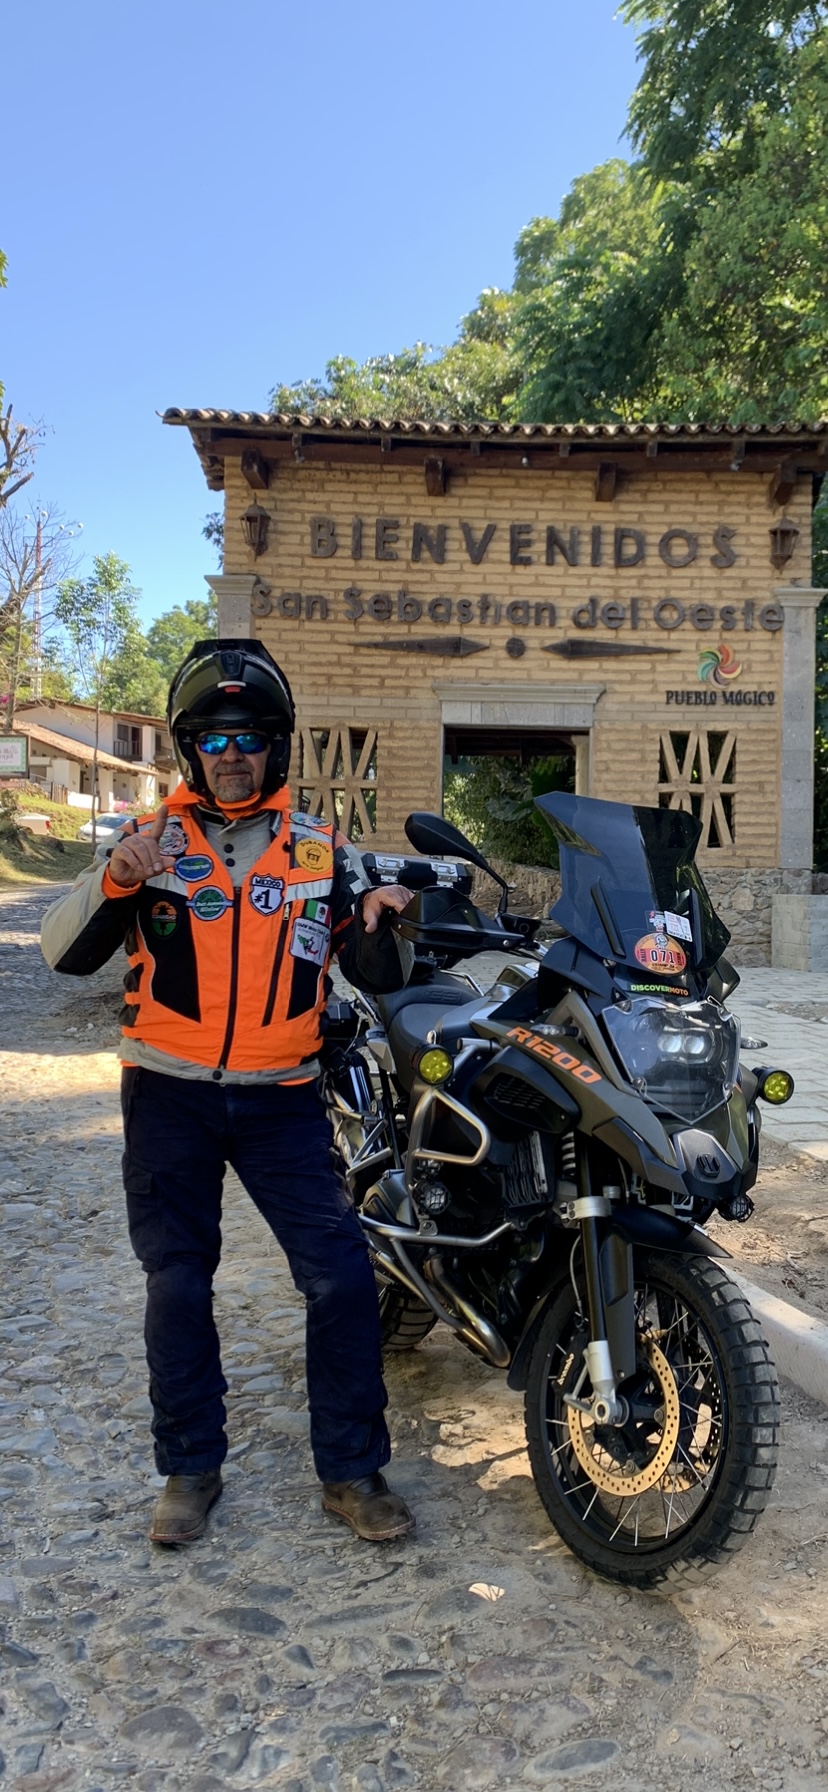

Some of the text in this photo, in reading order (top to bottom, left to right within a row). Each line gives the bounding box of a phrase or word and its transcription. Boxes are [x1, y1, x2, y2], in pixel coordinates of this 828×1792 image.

[309, 515, 738, 569] BIENVENIDOS
[250, 583, 329, 620] San
[571, 596, 638, 630] del
[652, 597, 784, 632] Oeste
[665, 690, 717, 705] PUEBLO
[254, 889, 273, 909] #1
[650, 949, 675, 964] 071
[505, 1025, 602, 1084] R1200
